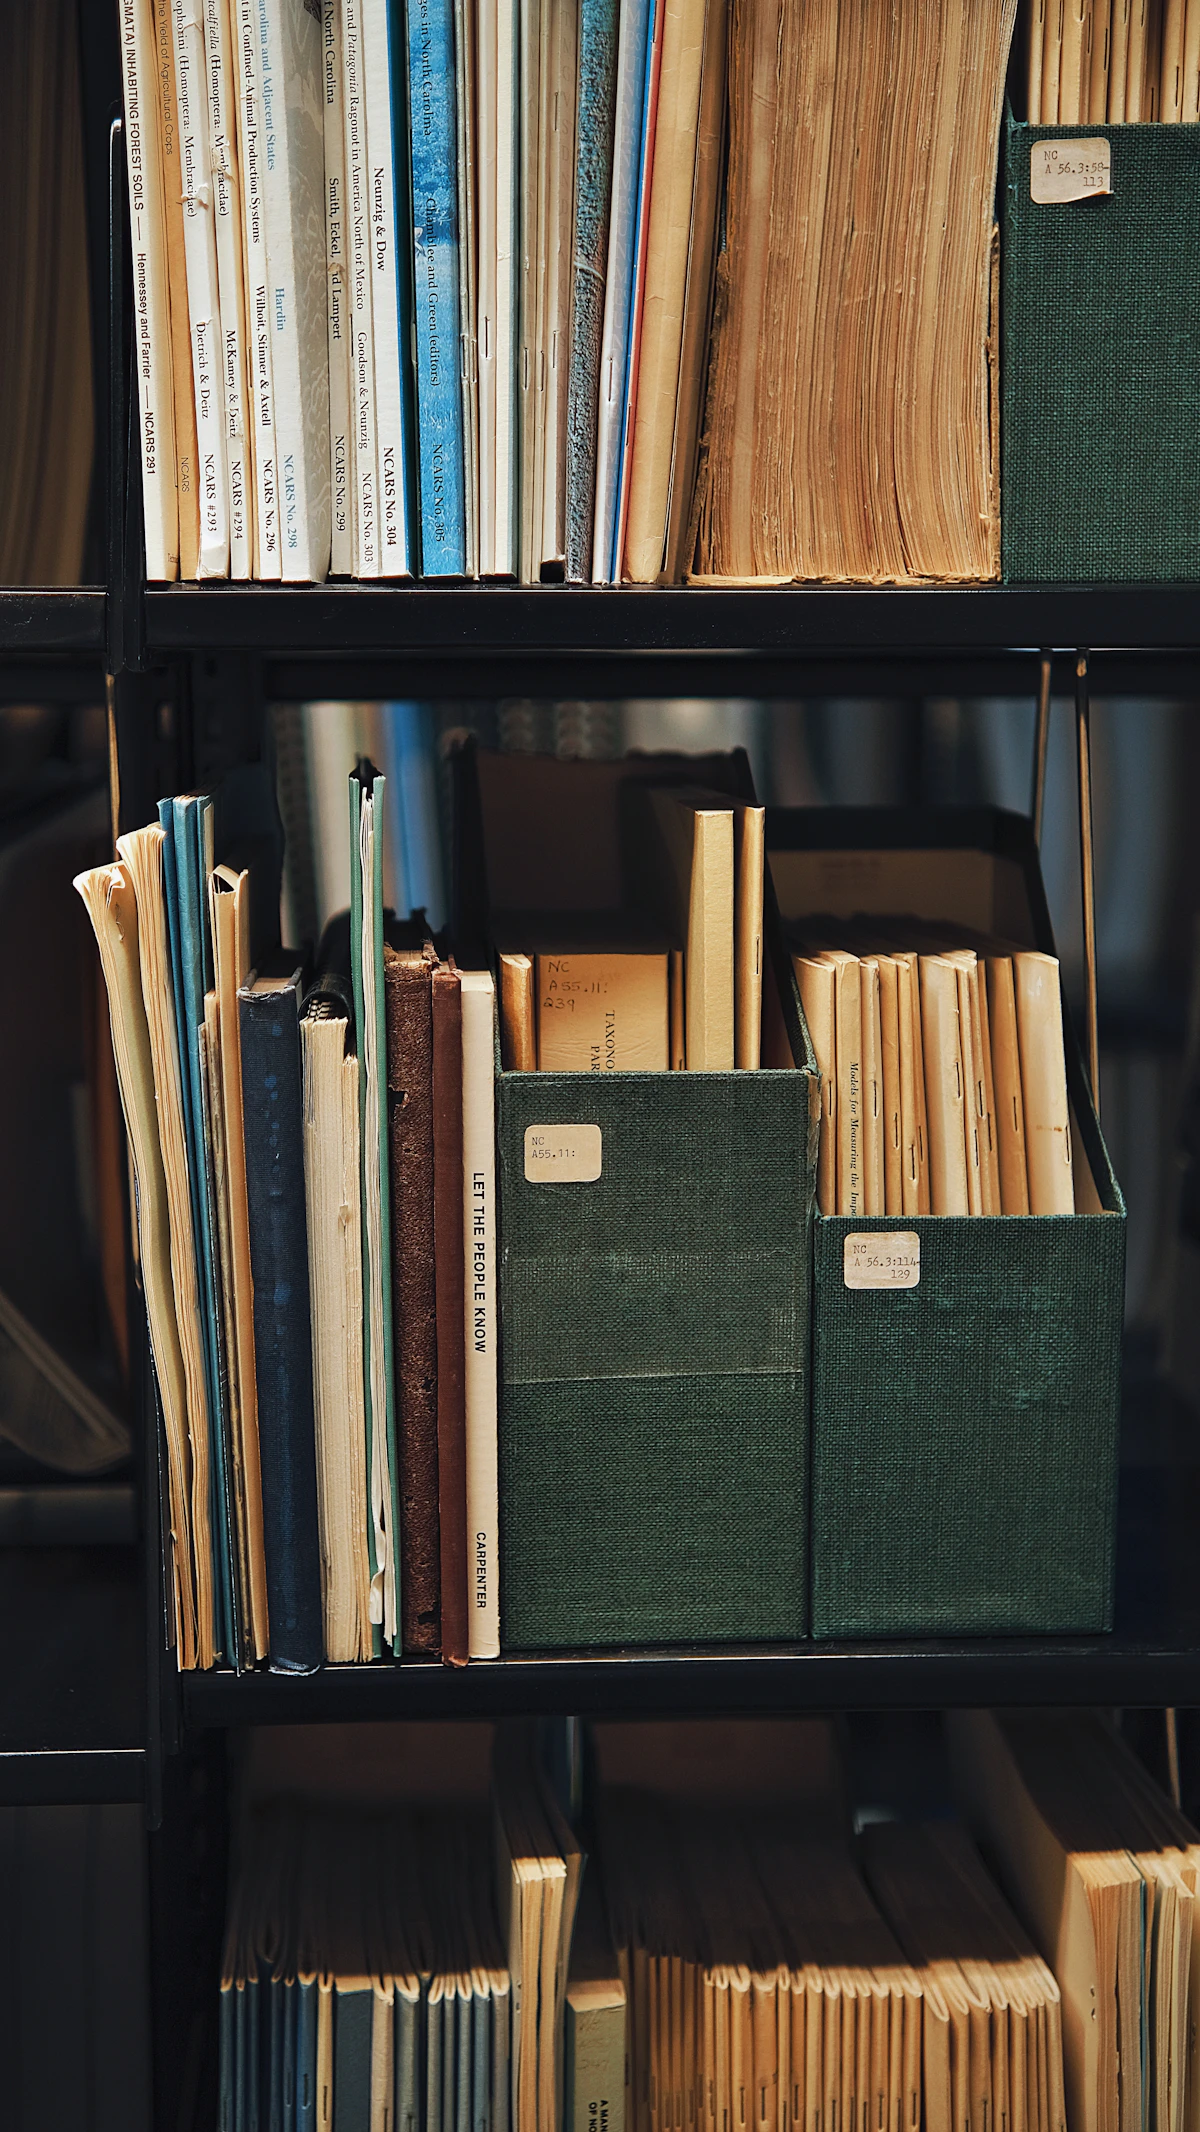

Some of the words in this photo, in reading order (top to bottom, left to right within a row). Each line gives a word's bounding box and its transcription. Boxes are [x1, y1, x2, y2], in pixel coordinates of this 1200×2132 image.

[123, 0, 135, 46] GMATA)
[242, 9, 251, 21] in
[324, 10, 335, 47] North
[346, 7, 357, 30] and
[421, 22, 431, 35] in
[159, 20, 168, 46] Yield
[161, 48, 170, 59] of
[262, 47, 271, 71] and
[346, 33, 359, 94] Patagonia
[421, 40, 432, 77] North
[126, 49, 139, 119] INHABITING
[160, 61, 171, 123] Agricultural
[209, 54, 221, 129] (Homoptera:
[242, 24, 257, 127] Confined-Animal
[325, 50, 336, 104] Carolina
[178, 55, 190, 130] (Homoptera:
[262, 75, 275, 131] Adjacent
[422, 81, 433, 136] Carolina
[347, 96, 360, 147] Ragonot
[130, 123, 142, 172] FOREST
[164, 126, 174, 155] Crops
[267, 134, 276, 170] States
[351, 149, 361, 160] in
[1044, 150, 1058, 160] NC
[247, 130, 260, 194] Production
[1045, 164, 1051, 174] A
[132, 174, 144, 210] SOILS
[328, 178, 340, 218] Smith,
[352, 164, 362, 212] America
[373, 167, 385, 222] Neunzig
[1083, 176, 1104, 187] 113
[249, 197, 261, 243] Systems
[354, 216, 364, 249] North
[376, 226, 386, 237] &
[425, 198, 437, 262] Chamblee
[330, 222, 341, 258] Eckel,
[376, 240, 387, 271] Dow
[331, 265, 341, 285] nd
[355, 253, 365, 265] of
[137, 253, 148, 315] Hennessey
[355, 269, 367, 310] Mexico
[427, 267, 438, 289] and
[255, 285, 267, 331] Wilhoit,
[275, 288, 286, 331] Hardin
[330, 289, 342, 340] Lampert
[427, 292, 438, 331] Green
[140, 318, 150, 339] and
[141, 342, 151, 379] Farrier
[196, 323, 209, 369] Dietrich
[225, 330, 237, 388] McKamey
[257, 334, 268, 376] Stinner
[357, 332, 368, 383] Goodson
[428, 335, 440, 387] (editors)
[200, 374, 210, 384] &
[260, 379, 269, 389] &
[359, 387, 369, 397] &
[201, 389, 211, 419] Deitz
[229, 394, 239, 404] &
[261, 393, 272, 426] Axtell
[144, 412, 155, 453] NCARS
[229, 408, 239, 438] Deitz
[358, 400, 370, 449] Neunzig
[146, 457, 156, 475] 291
[181, 457, 190, 493] NCARS
[335, 435, 346, 483] NCARS
[383, 447, 395, 496] NCARS
[432, 444, 444, 493] NCARS
[204, 454, 217, 499] NCARS
[231, 461, 243, 506] NCARS
[263, 459, 274, 504] NCARS
[284, 454, 295, 501] NCARS
[336, 487, 346, 508] No.
[362, 473, 373, 518] NCARS
[385, 501, 396, 522] No.
[433, 497, 444, 518] No.
[207, 505, 217, 532] #293
[234, 512, 243, 539] #294
[265, 510, 275, 529] No.
[286, 505, 296, 524] No.
[336, 512, 346, 531] 299
[363, 521, 373, 541] No.
[266, 533, 276, 552] 296
[287, 529, 297, 548] 298
[386, 525, 397, 546] 304
[434, 521, 445, 542] 305
[364, 544, 374, 562] 303
[548, 960, 571, 973] NC
[605, 1010, 616, 1069] TAXONO
[591, 1045, 601, 1071] PAR
[850, 1062, 859, 1096] Models
[850, 1100, 859, 1115] for
[531, 1137, 545, 1146] NC
[531, 1149, 575, 1159] A55.11:
[850, 1119, 859, 1169] Measuring
[473, 1172, 485, 1200] LET
[851, 1173, 859, 1188] the
[473, 1206, 485, 1236] THE
[853, 1245, 867, 1254] NC
[854, 1258, 860, 1267] A
[474, 1243, 486, 1301] PEOPLE
[891, 1270, 911, 1280] 129
[474, 1307, 486, 1353] KNOW
[476, 1532, 487, 1609] CARPENTER
[588, 2102, 597, 2115] OF
[600, 2110, 608, 2132] MAN
[589, 2119, 597, 2132] NO
